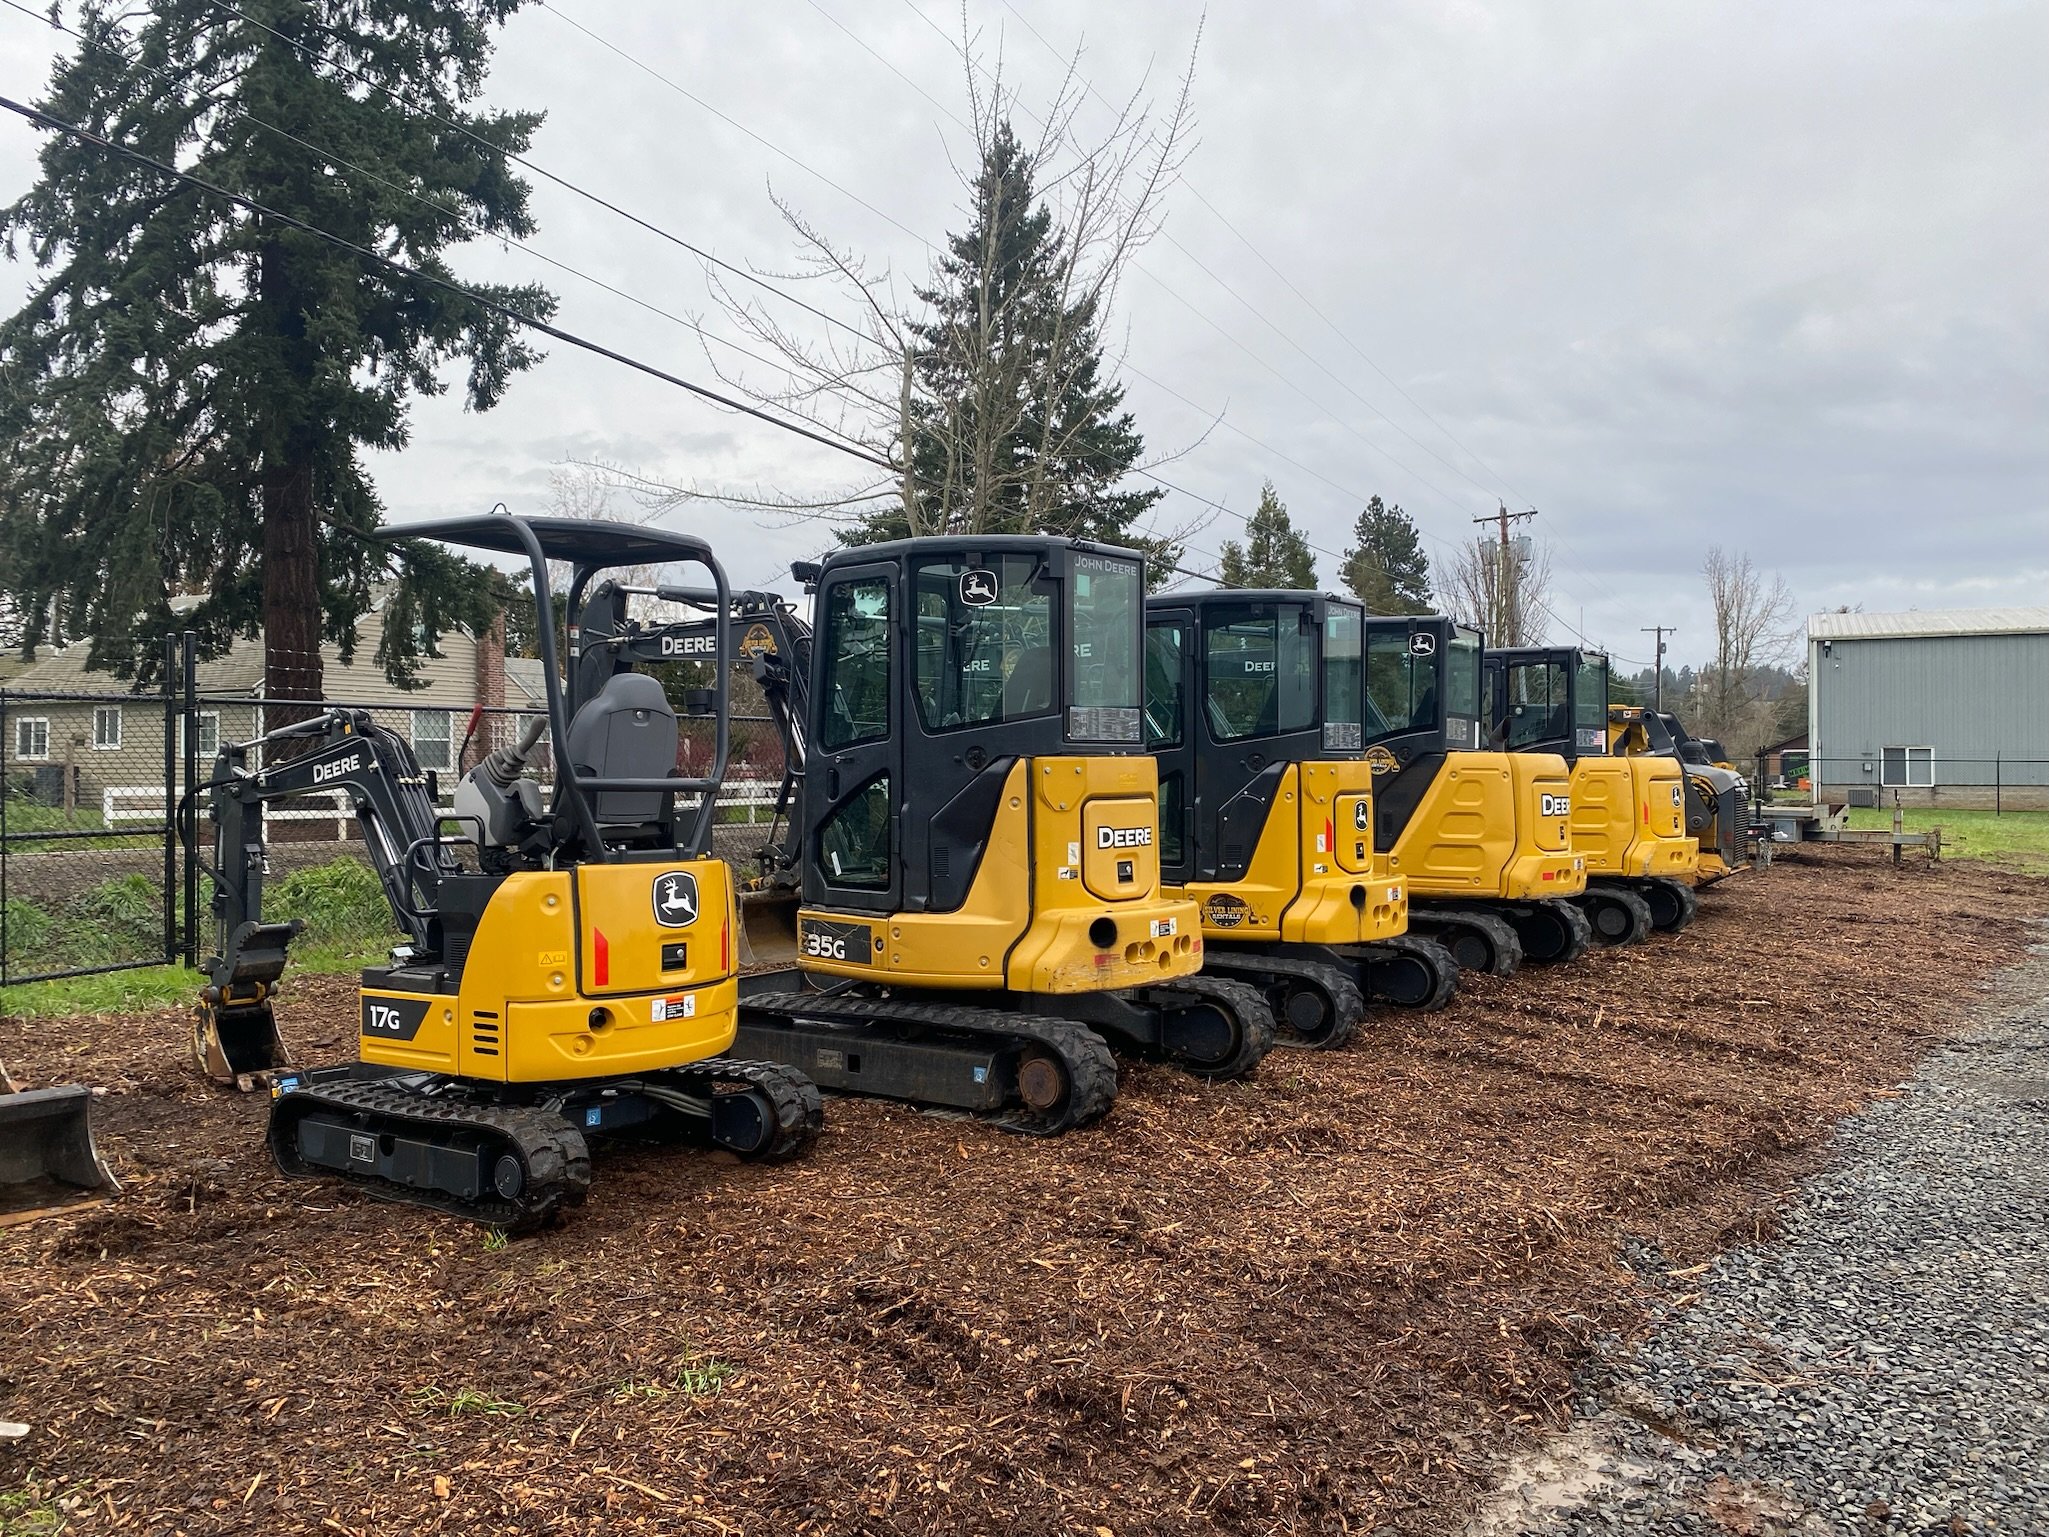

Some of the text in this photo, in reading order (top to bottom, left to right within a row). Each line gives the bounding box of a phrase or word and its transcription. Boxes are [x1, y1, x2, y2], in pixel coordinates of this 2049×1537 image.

[1074, 555, 1137, 577] JOHN DEERE
[661, 635, 716, 655] DEERE
[963, 660, 990, 672] ERE
[312, 753, 361, 784] DEERE
[1097, 826, 1152, 849] DEERE
[1204, 905, 1249, 914] SILVER LINING
[807, 933, 846, 960] 35G
[369, 1004, 401, 1030] 17G
